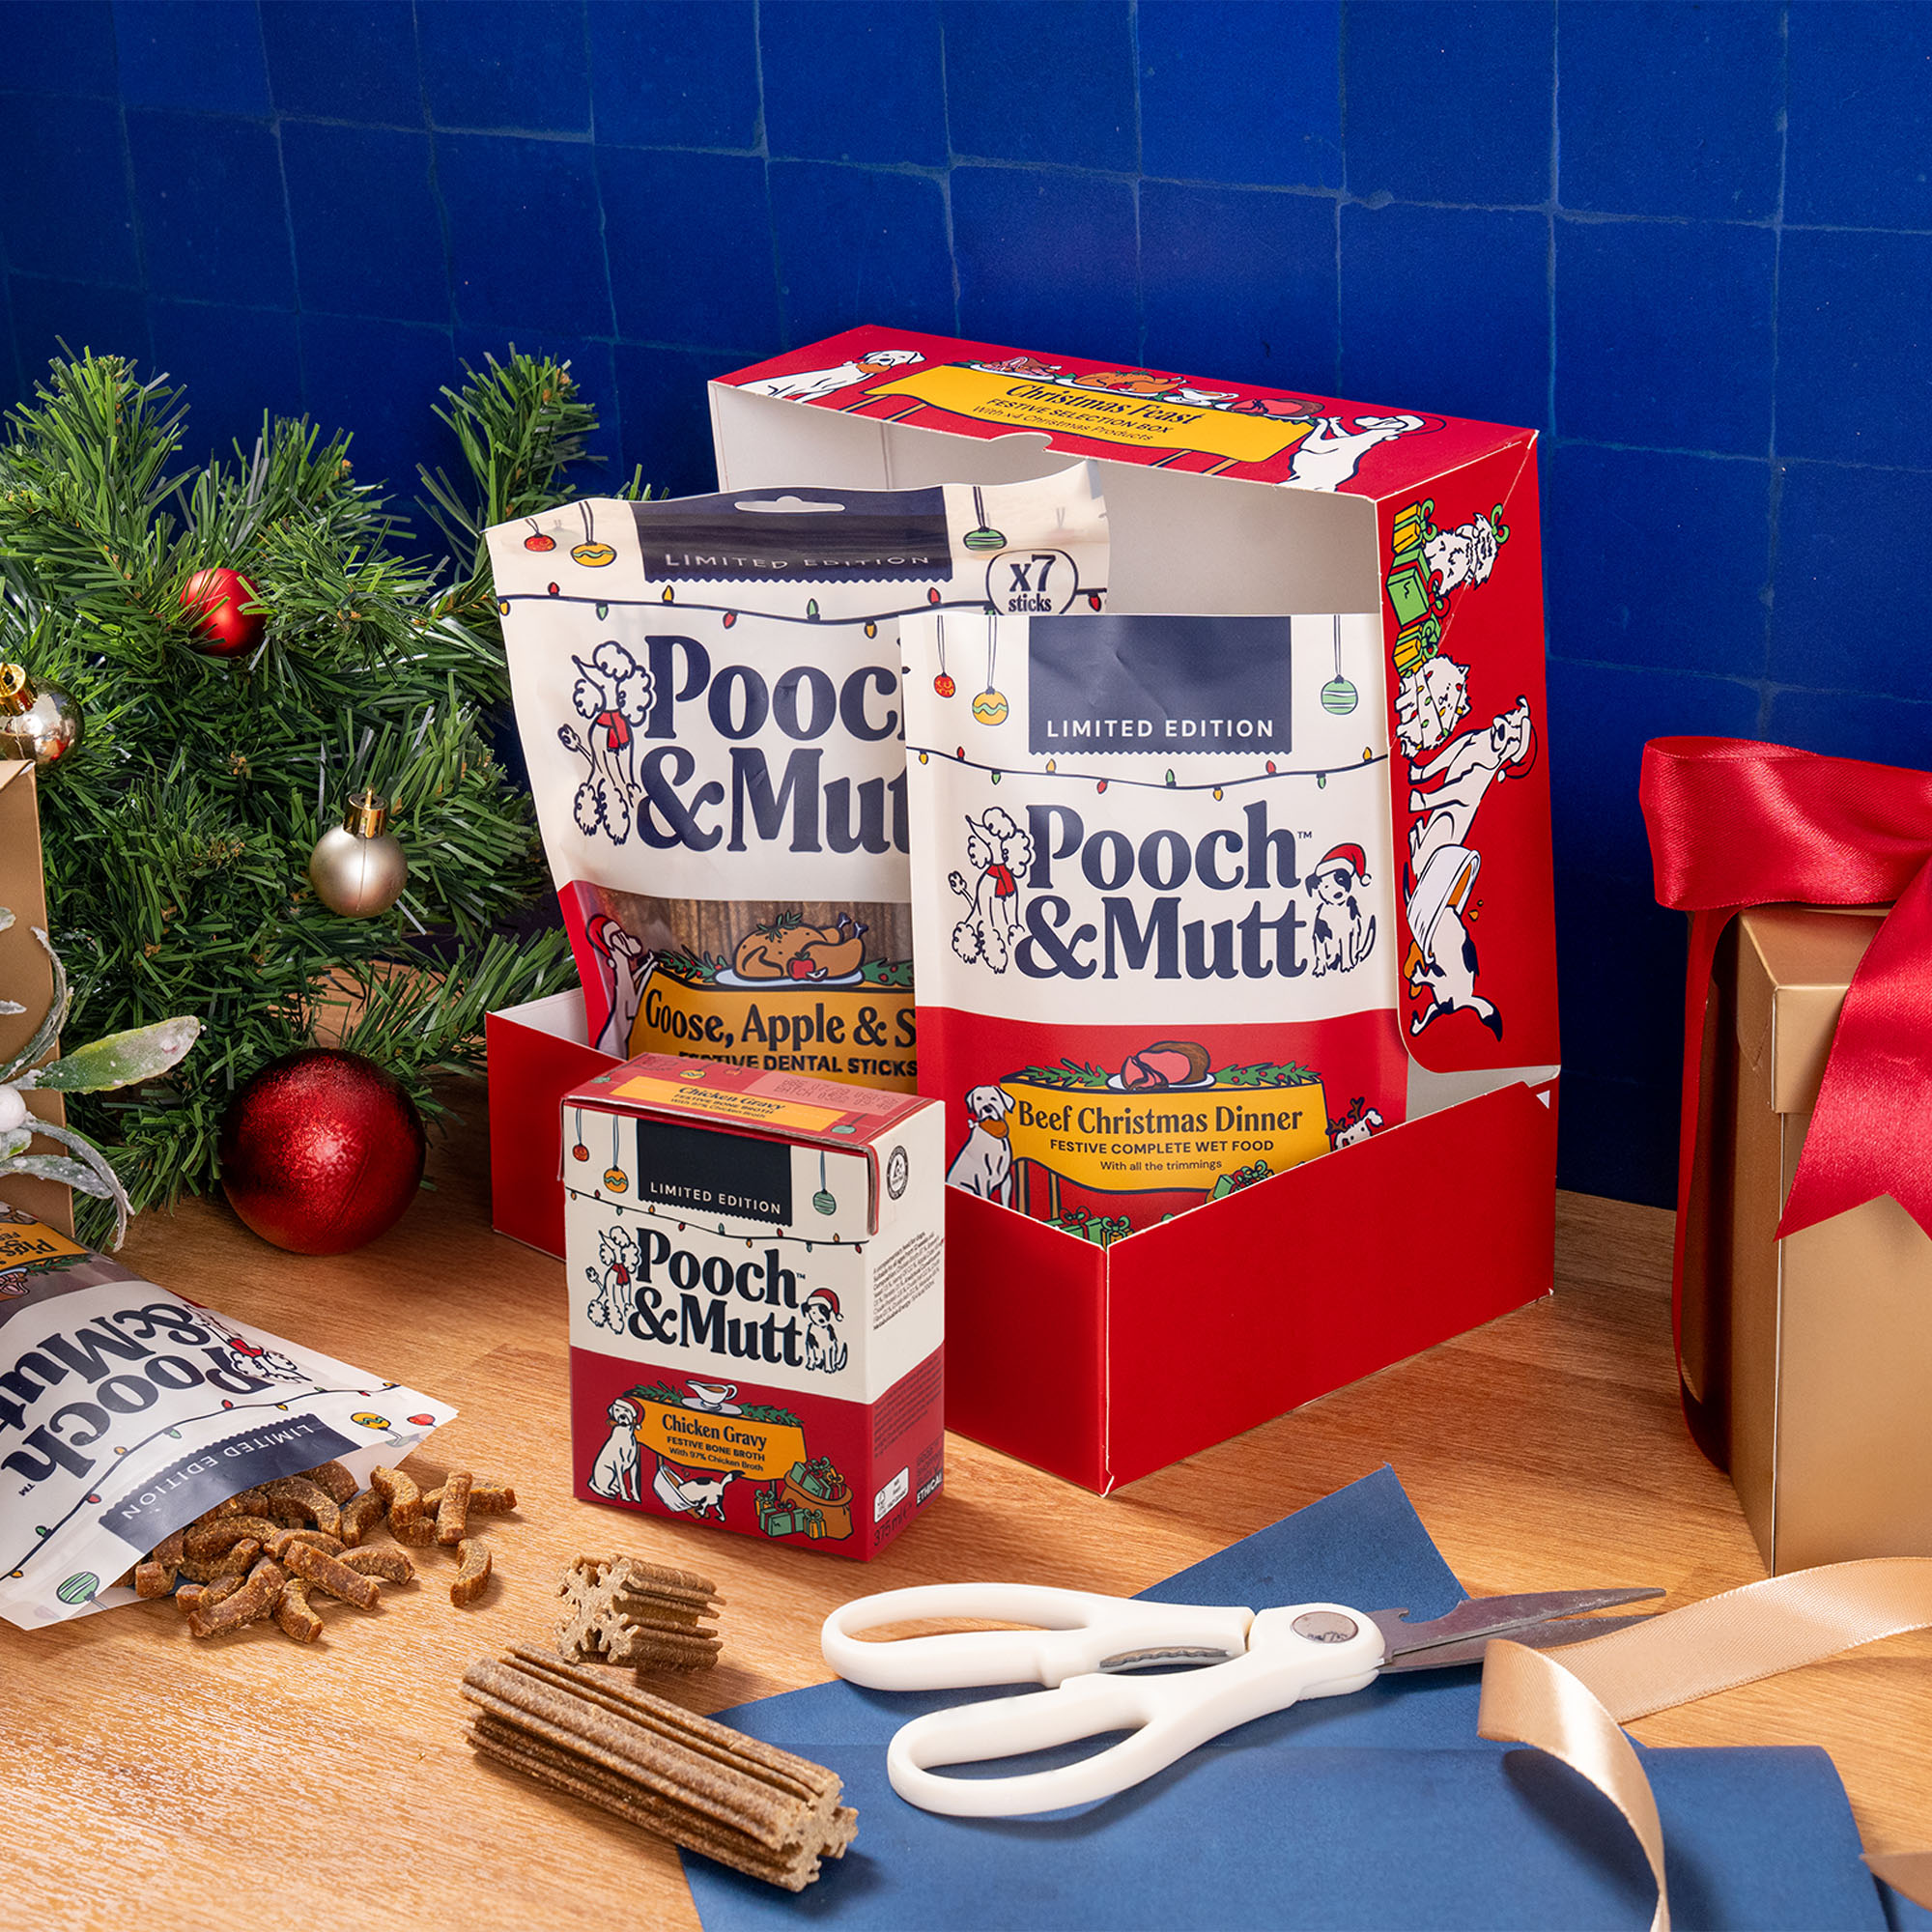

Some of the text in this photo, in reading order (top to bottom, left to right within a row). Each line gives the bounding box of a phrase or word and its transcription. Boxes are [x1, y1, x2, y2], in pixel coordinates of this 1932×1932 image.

[986, 398, 1175, 434] FESTIVE SELECTION BOX
[1007, 384, 1206, 425] Christmas Feast
[973, 405, 1004, 417] With
[1022, 414, 1091, 432] Christmas
[1091, 425, 1153, 441] Products
[666, 554, 930, 570] LIMITED EDITION
[1009, 554, 1057, 592] x7
[1009, 593, 1052, 612] sticks
[644, 635, 906, 742] Pooc
[1046, 720, 1274, 738] LIMITED EDITION
[638, 746, 910, 855] &Mut
[1026, 801, 1300, 893] Pooch
[1014, 895, 1312, 981] &Mutt
[645, 988, 734, 1049] Goose,
[741, 1003, 845, 1052] Apple
[852, 1006, 888, 1048] &
[763, 1055, 843, 1073] DENTAL
[847, 1058, 917, 1077] STICKS
[679, 1087, 786, 1111] Chicken Gravy
[1018, 1099, 1303, 1135] Beef Christmas Dinner
[1050, 1139, 1274, 1154] FESTIVE COMPLETE WET FOOD
[1100, 1159, 1222, 1172] With all the trimmings
[650, 1181, 781, 1214] LIMITED EDITION
[636, 1227, 799, 1309] Pooch
[628, 1286, 804, 1368] &Mutt
[1, 1346, 275, 1482] Pooch
[662, 1413, 767, 1452] Chicken Gravy
[667, 1435, 765, 1462] FESTIVE BONE BROTH
[121, 1424, 315, 1520] LIMITED EDITION
[668, 1446, 764, 1472] With 97% Chicken Broth
